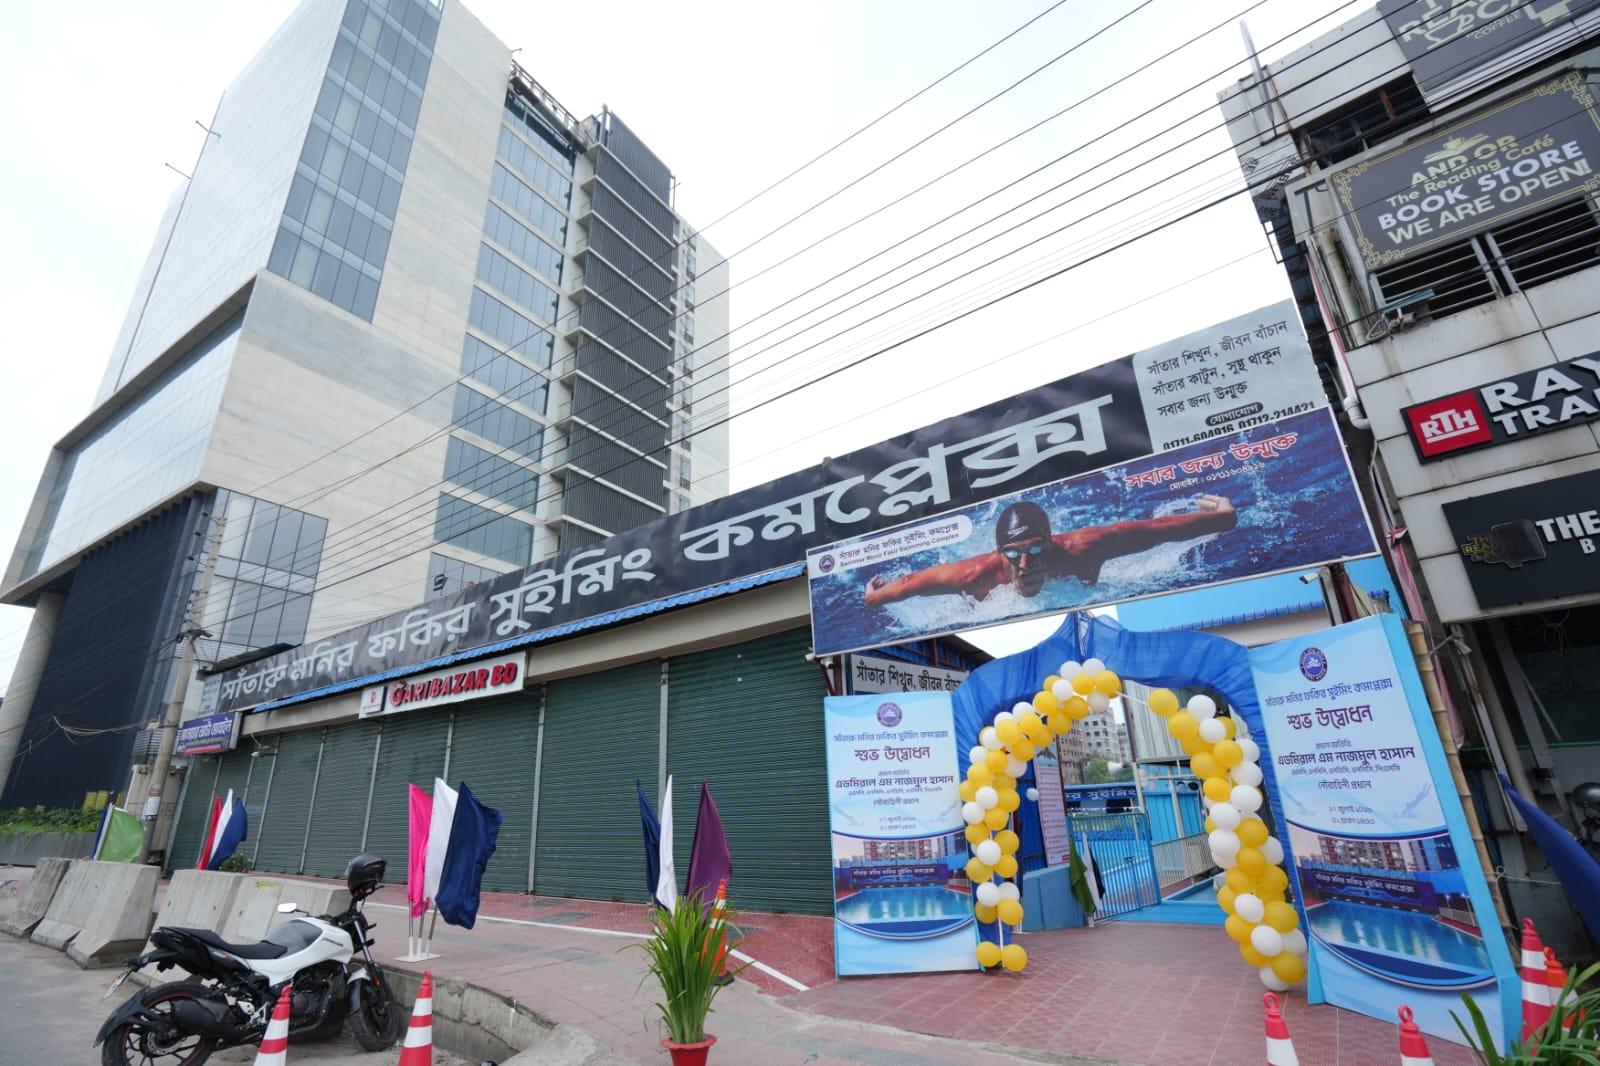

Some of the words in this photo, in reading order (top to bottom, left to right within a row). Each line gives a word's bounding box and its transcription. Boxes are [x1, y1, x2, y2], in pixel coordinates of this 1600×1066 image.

[1386, 191, 1420, 208] The
[1424, 158, 1501, 194] Reading
[1505, 134, 1555, 161] Café
[1411, 156, 1468, 187] AND
[1474, 135, 1519, 160] OR
[1378, 183, 1469, 230] BOOK
[1478, 140, 1583, 192] STORE
[1387, 217, 1434, 244] WE
[1439, 194, 1495, 228] ARE
[1147, 358, 1180, 376] সাঁতার
[1219, 332, 1251, 351] জীবন
[1254, 320, 1288, 339] বাঁচান
[1152, 376, 1185, 396] সাঁতার
[1249, 346, 1282, 366] থাকুন
[1157, 401, 1185, 418] সবার
[1188, 393, 1211, 408] জন্য
[1214, 381, 1248, 401] উন্মুক্ত
[1492, 388, 1600, 435] TRA
[1420, 408, 1479, 438] RTH
[1124, 464, 1176, 489] সবার
[1179, 451, 1226, 474] জন্য
[1229, 432, 1299, 461] উন্মুক্ত
[221, 664, 288, 700] সাঁতারু
[290, 641, 358, 681] মনির
[368, 602, 476, 658] ফকির
[490, 548, 656, 635] সুইমিং
[679, 394, 1113, 562] কমপ্লেক্স
[1536, 510, 1600, 542] THE
[491, 662, 518, 686] BD
[856, 659, 885, 685] সাঁতার
[917, 670, 942, 691] জীবন
[1287, 712, 1312, 730] শুভ
[1315, 704, 1373, 729] উদ্বোধন
[855, 749, 879, 761] শুভ
[884, 746, 930, 762] উদ্বোধন
[1278, 751, 1316, 765] এডমিরাল
[1318, 752, 1333, 763] এম
[1335, 749, 1376, 765] নাজমুল
[1378, 747, 1416, 760] হাসান
[836, 776, 875, 788] এডমিরাল
[878, 778, 892, 786] এম
[895, 776, 927, 788] নাজমুল
[929, 775, 954, 784] হাসান
